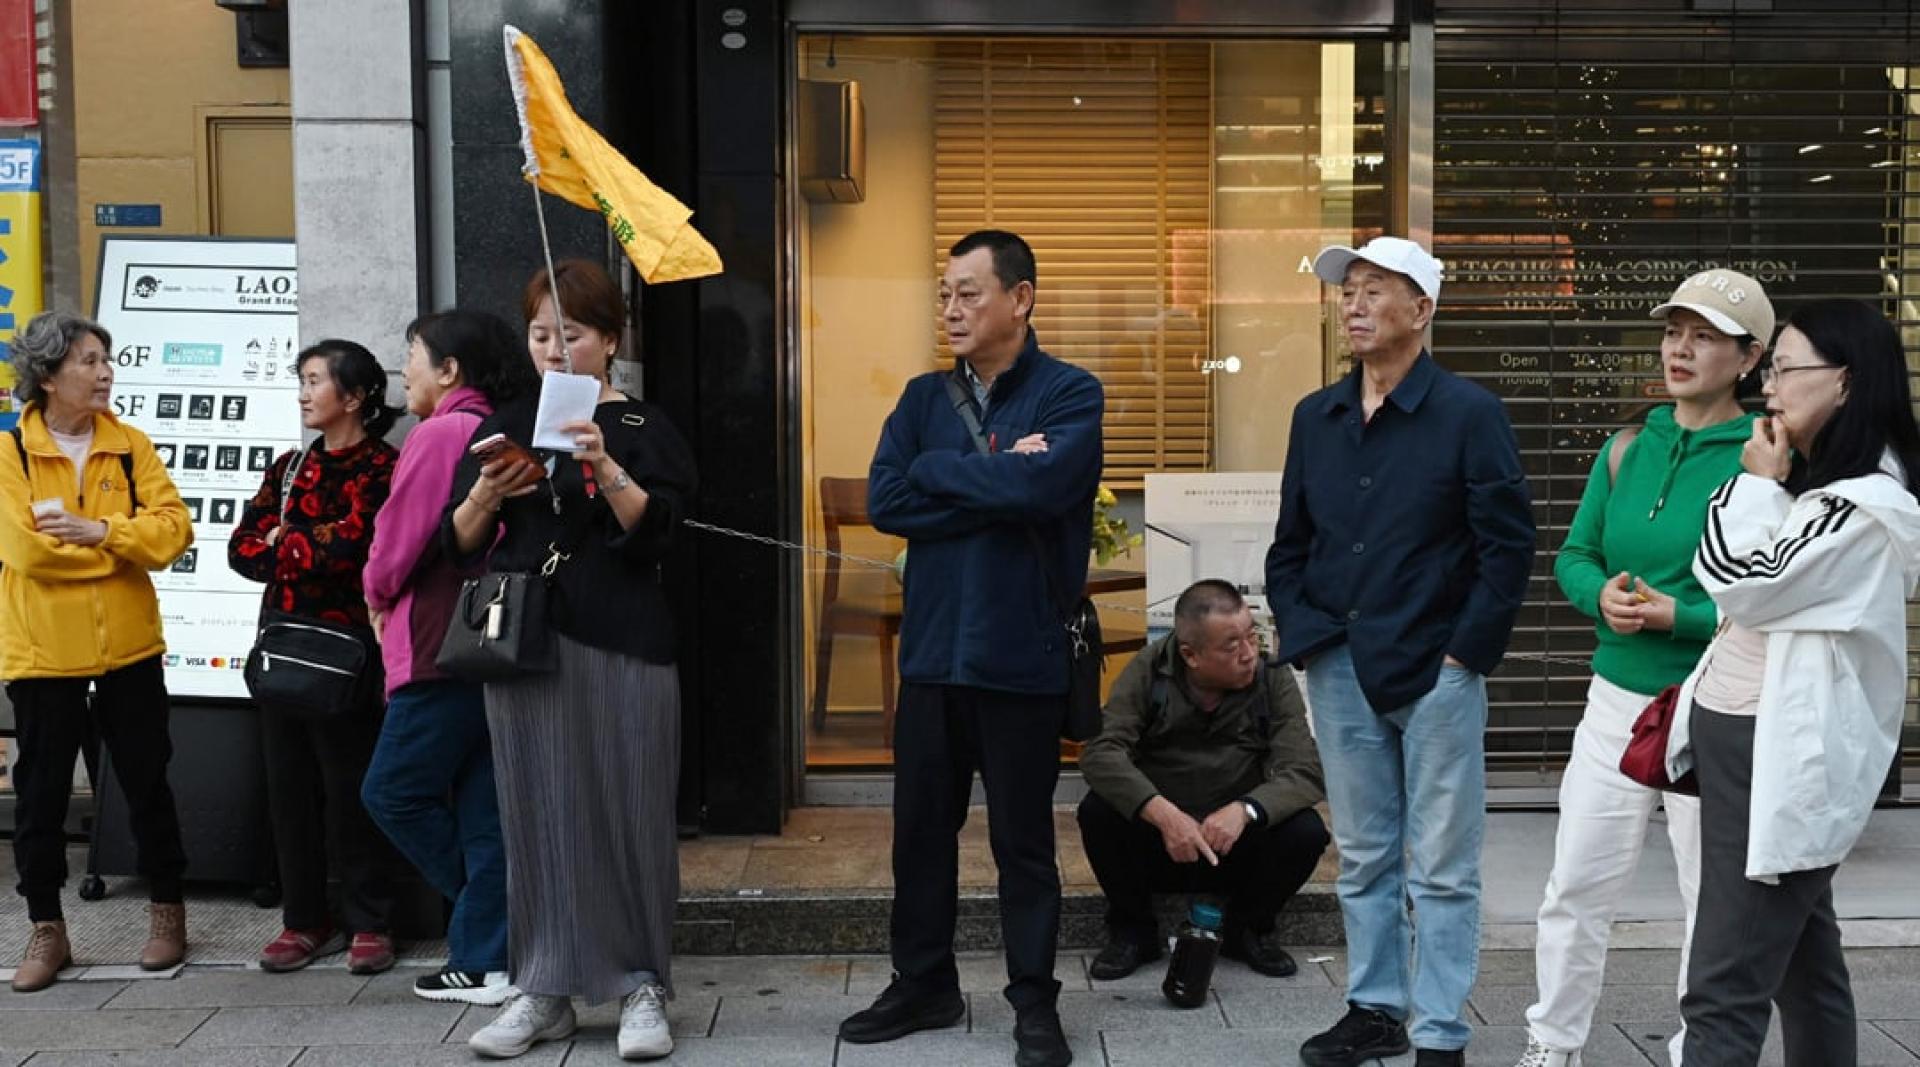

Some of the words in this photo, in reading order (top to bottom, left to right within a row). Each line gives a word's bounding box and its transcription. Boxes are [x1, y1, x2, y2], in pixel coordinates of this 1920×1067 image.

[1615, 260, 1797, 282] CORPORTION
[235, 275, 297, 294] LAO
[239, 296, 271, 305] Grand
[118, 345, 151, 367] 6F
[1499, 353, 1539, 371] Open
[113, 394, 146, 417] 5F
[185, 657, 207, 666] VISA
